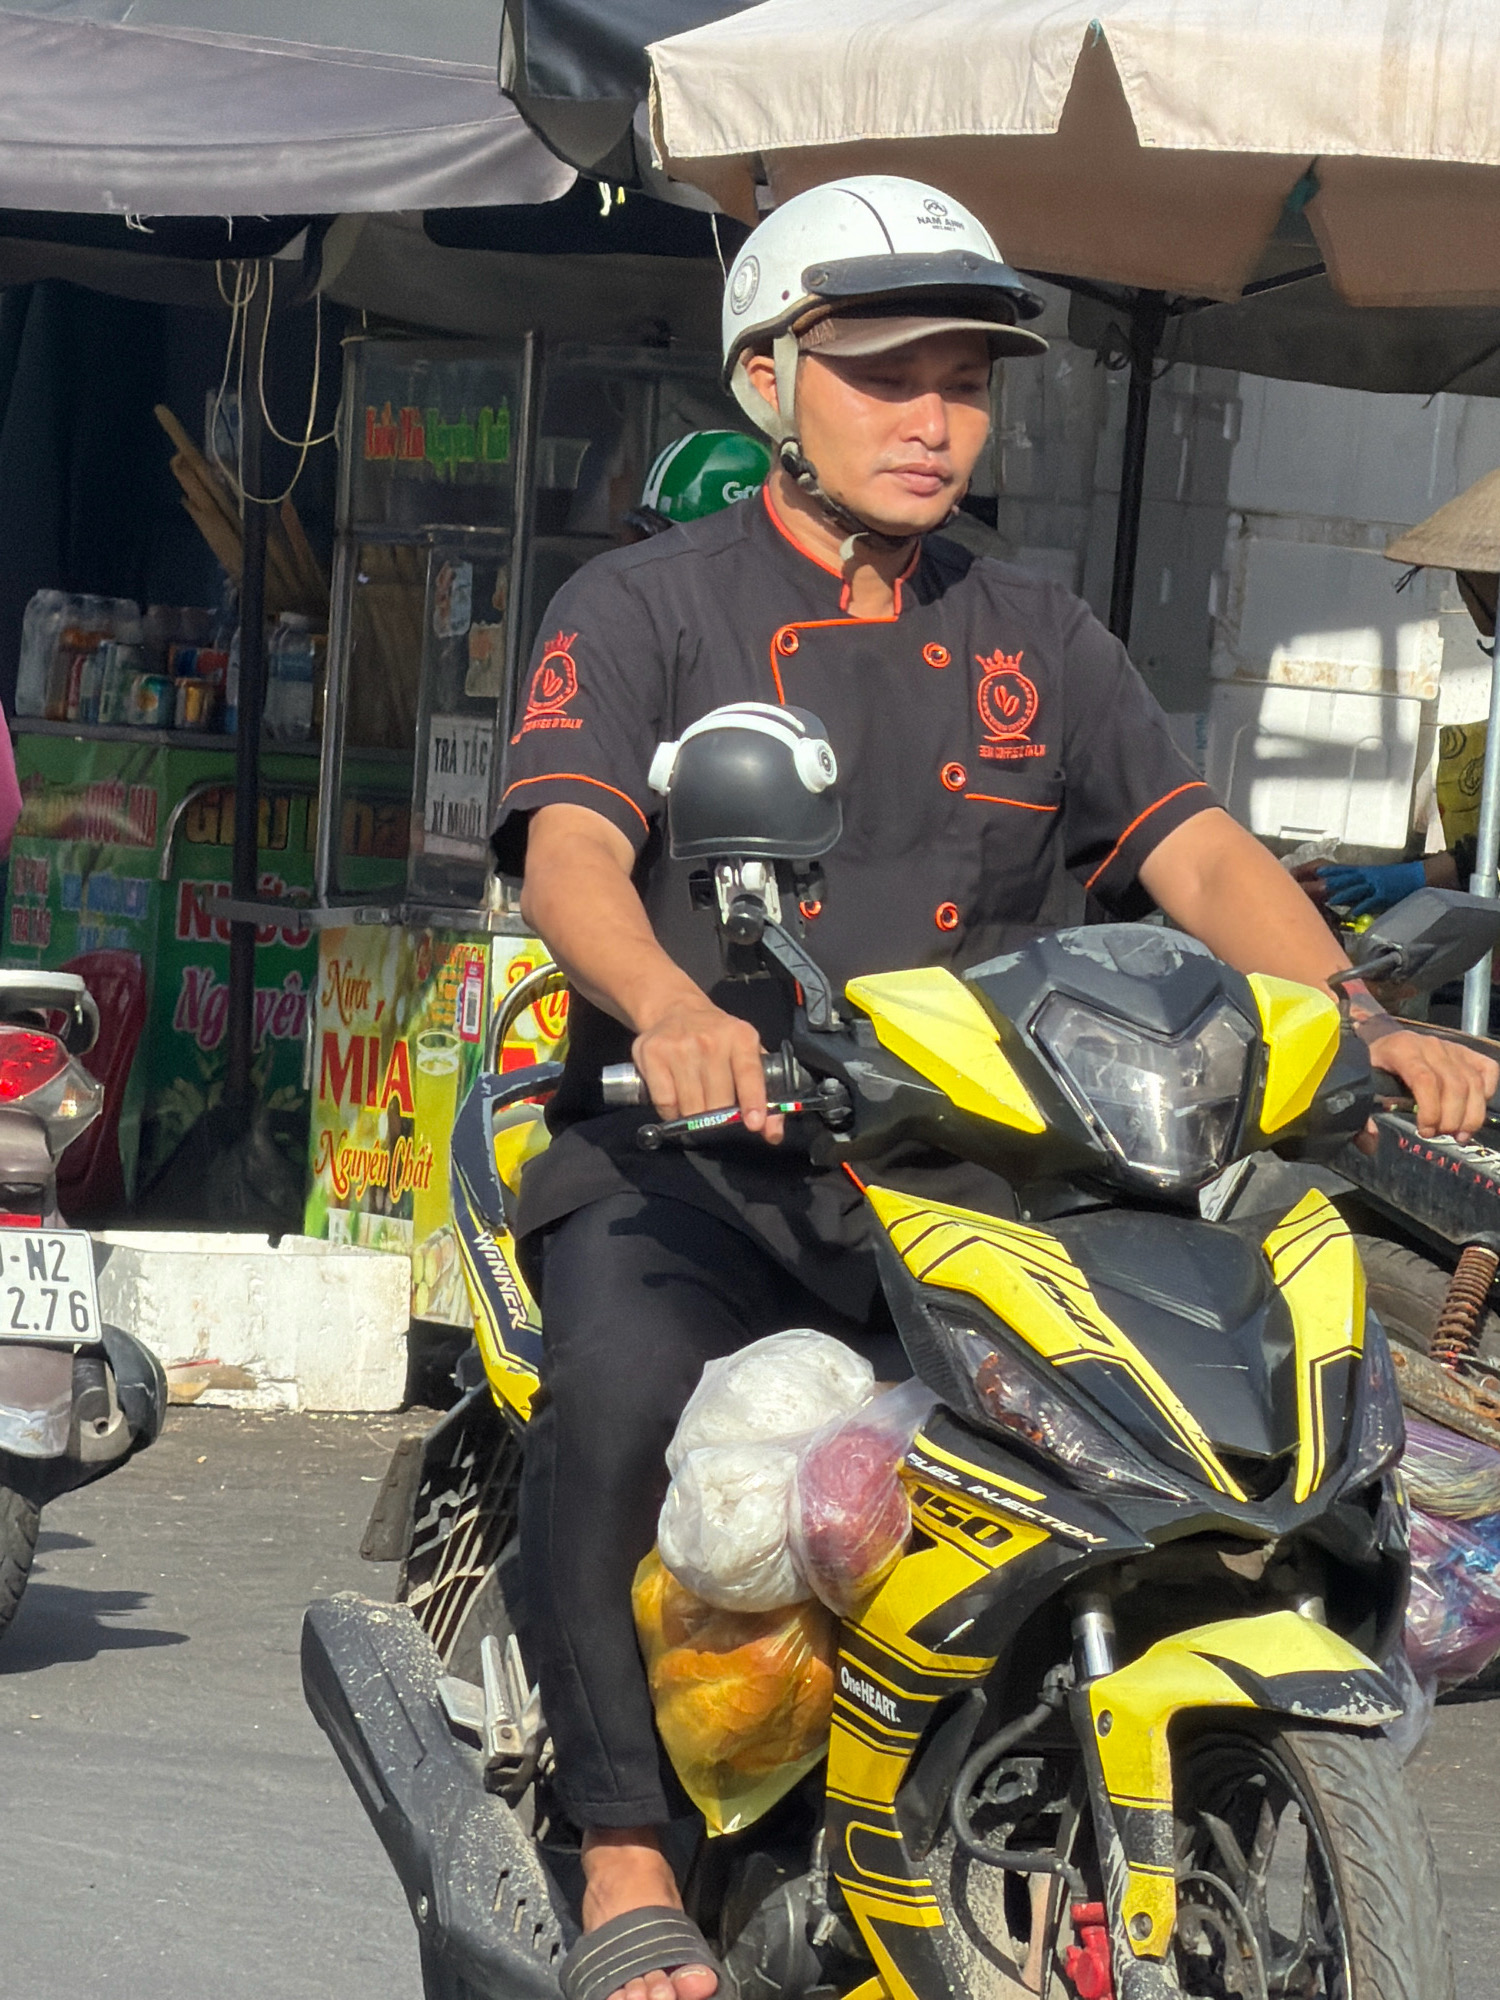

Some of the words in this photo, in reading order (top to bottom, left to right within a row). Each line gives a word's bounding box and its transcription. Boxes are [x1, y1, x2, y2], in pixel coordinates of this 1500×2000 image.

[916, 216, 942, 225] NAM
[722, 481, 761, 504] Gr
[319, 999, 415, 1116] MÍA
[314, 1129, 390, 1201] Nguyên
[389, 1135, 434, 1204] Chất
[1398, 1137, 1463, 1176] URBAN
[0, 1238, 70, 1282] -N2
[473, 1231, 527, 1330] WINNER
[7, 1286, 90, 1333] 2.76
[907, 1452, 962, 1486] FUEL
[912, 1485, 1014, 1549] 150
[966, 1485, 1108, 1544] INJECTION
